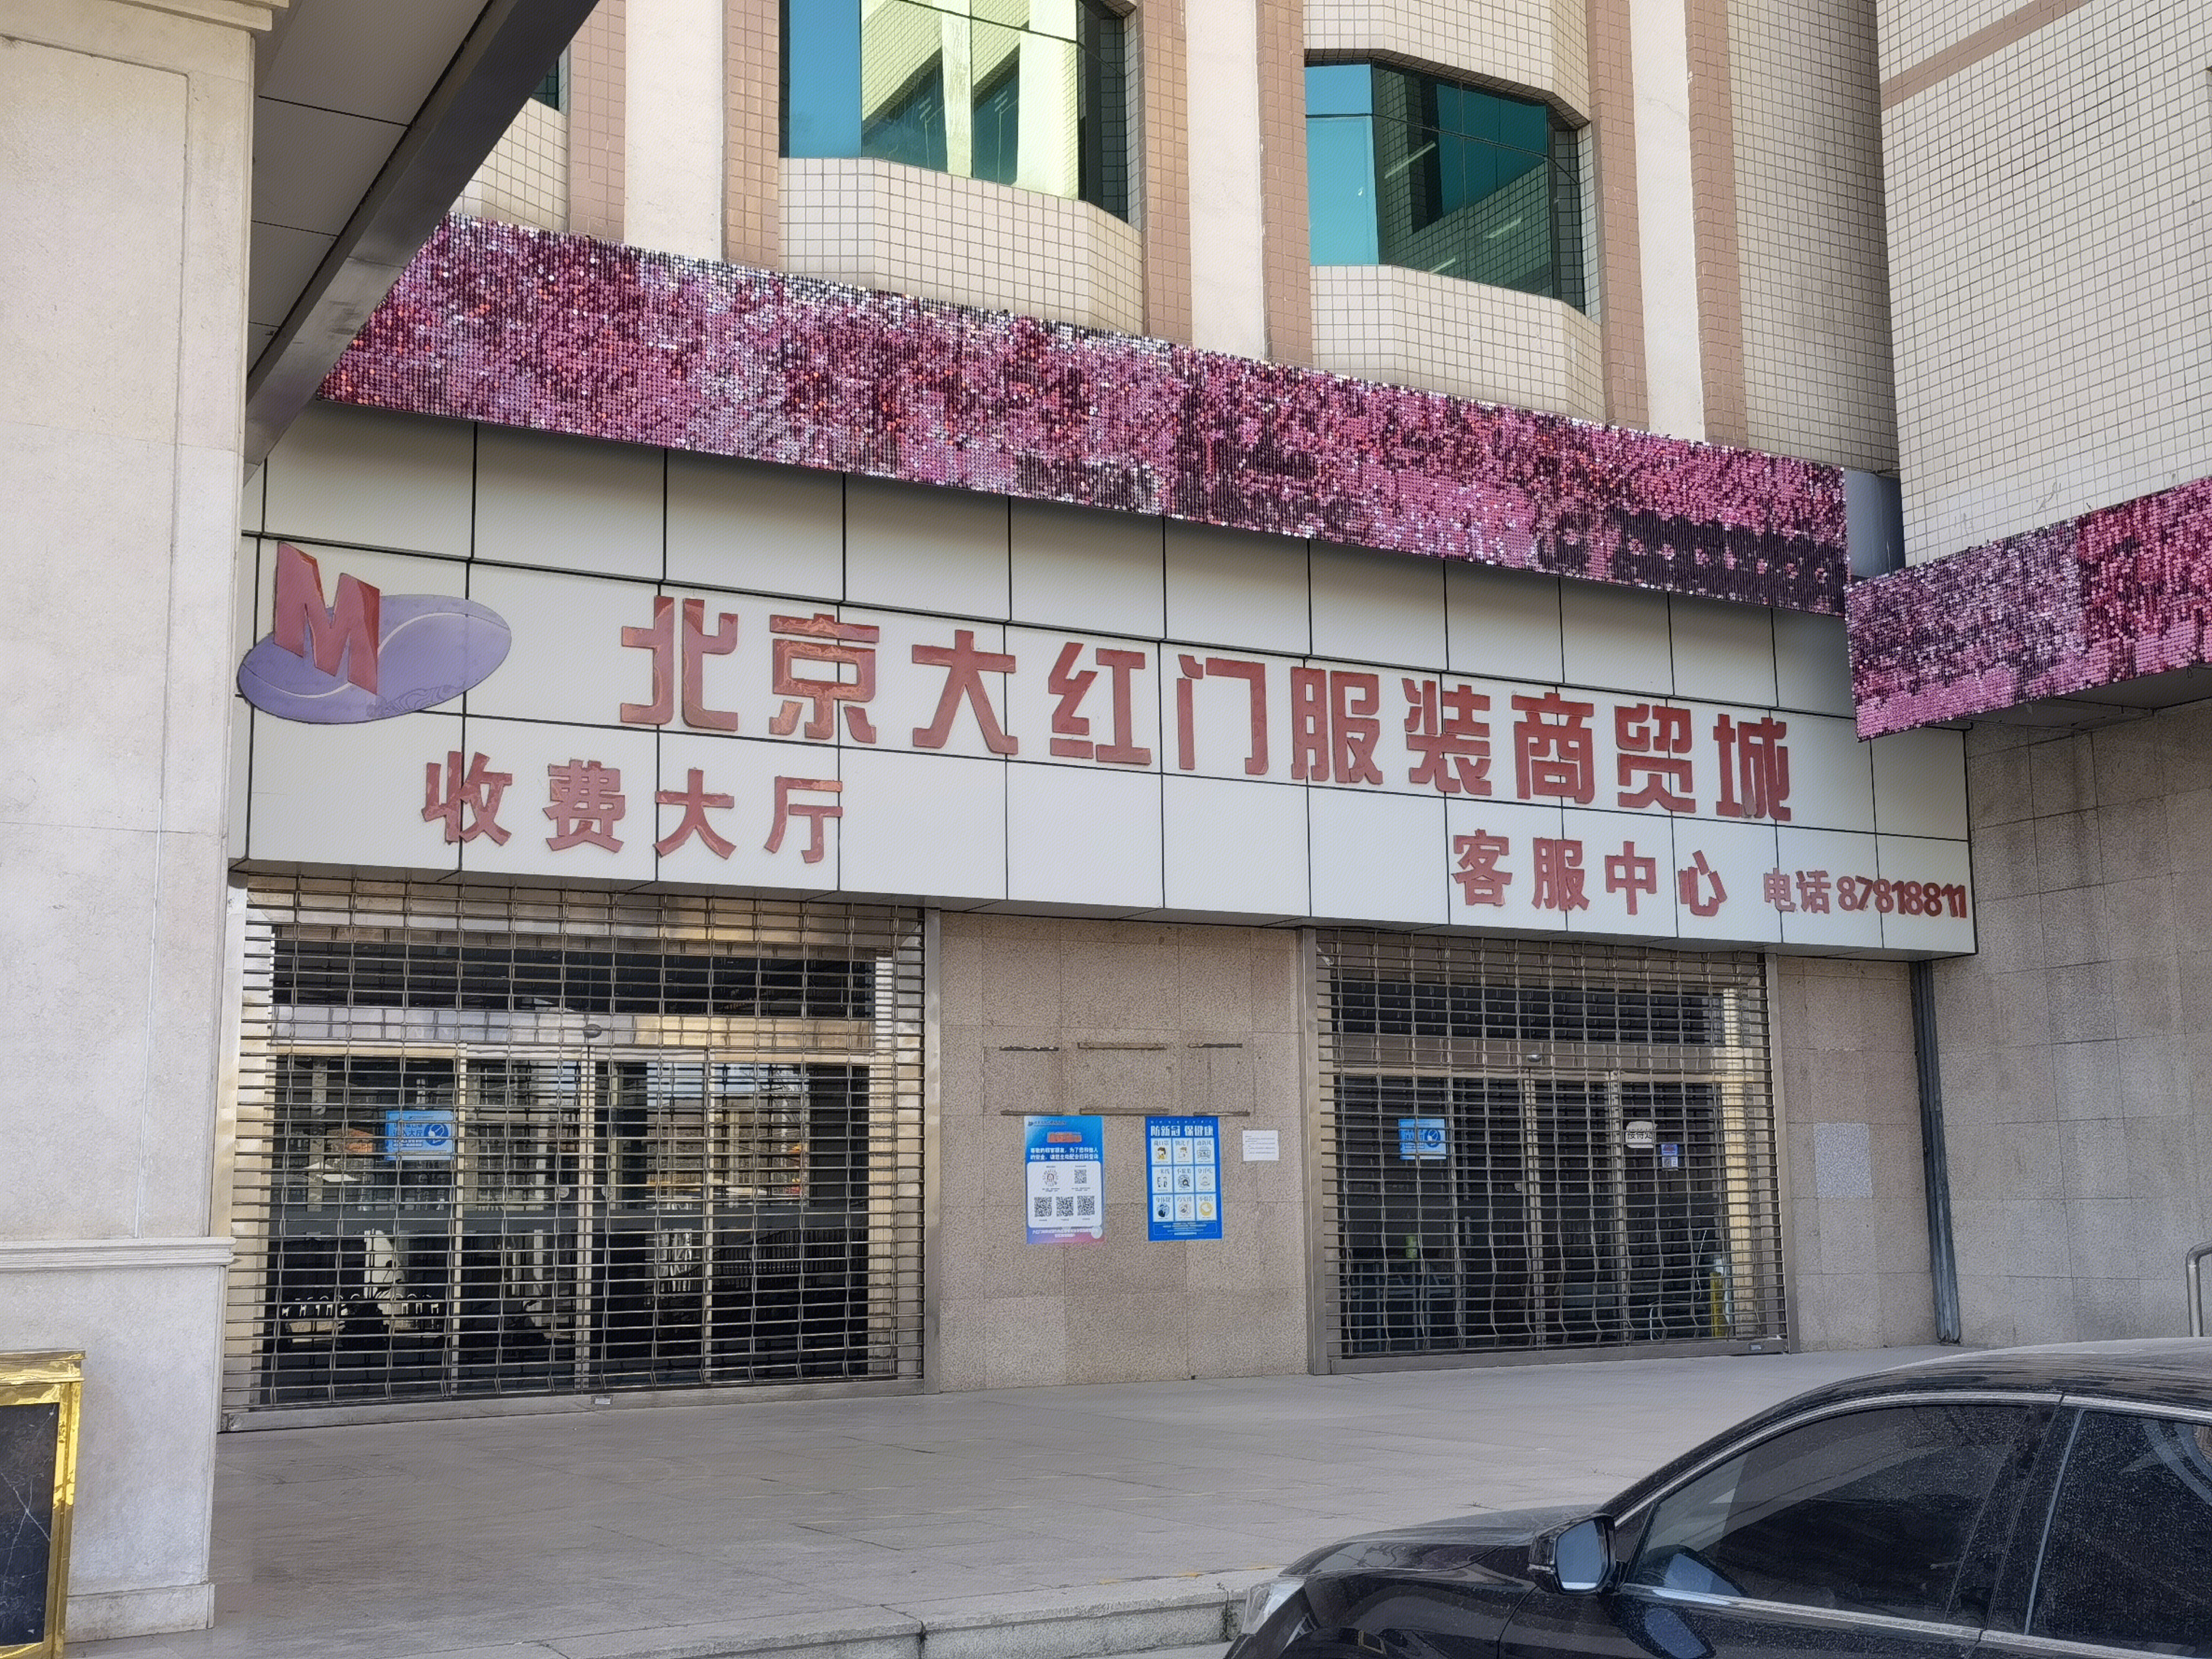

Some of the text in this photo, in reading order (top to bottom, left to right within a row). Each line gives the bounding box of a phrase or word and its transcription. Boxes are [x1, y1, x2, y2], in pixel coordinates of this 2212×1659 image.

[273, 541, 380, 695] M
[619, 595, 1792, 822] 北京大红门服装商贸城
[421, 751, 843, 864] 收费大厅
[1451, 828, 1728, 918] 客服中心
[1150, 1125, 1213, 1137] 防新冠 保健康
